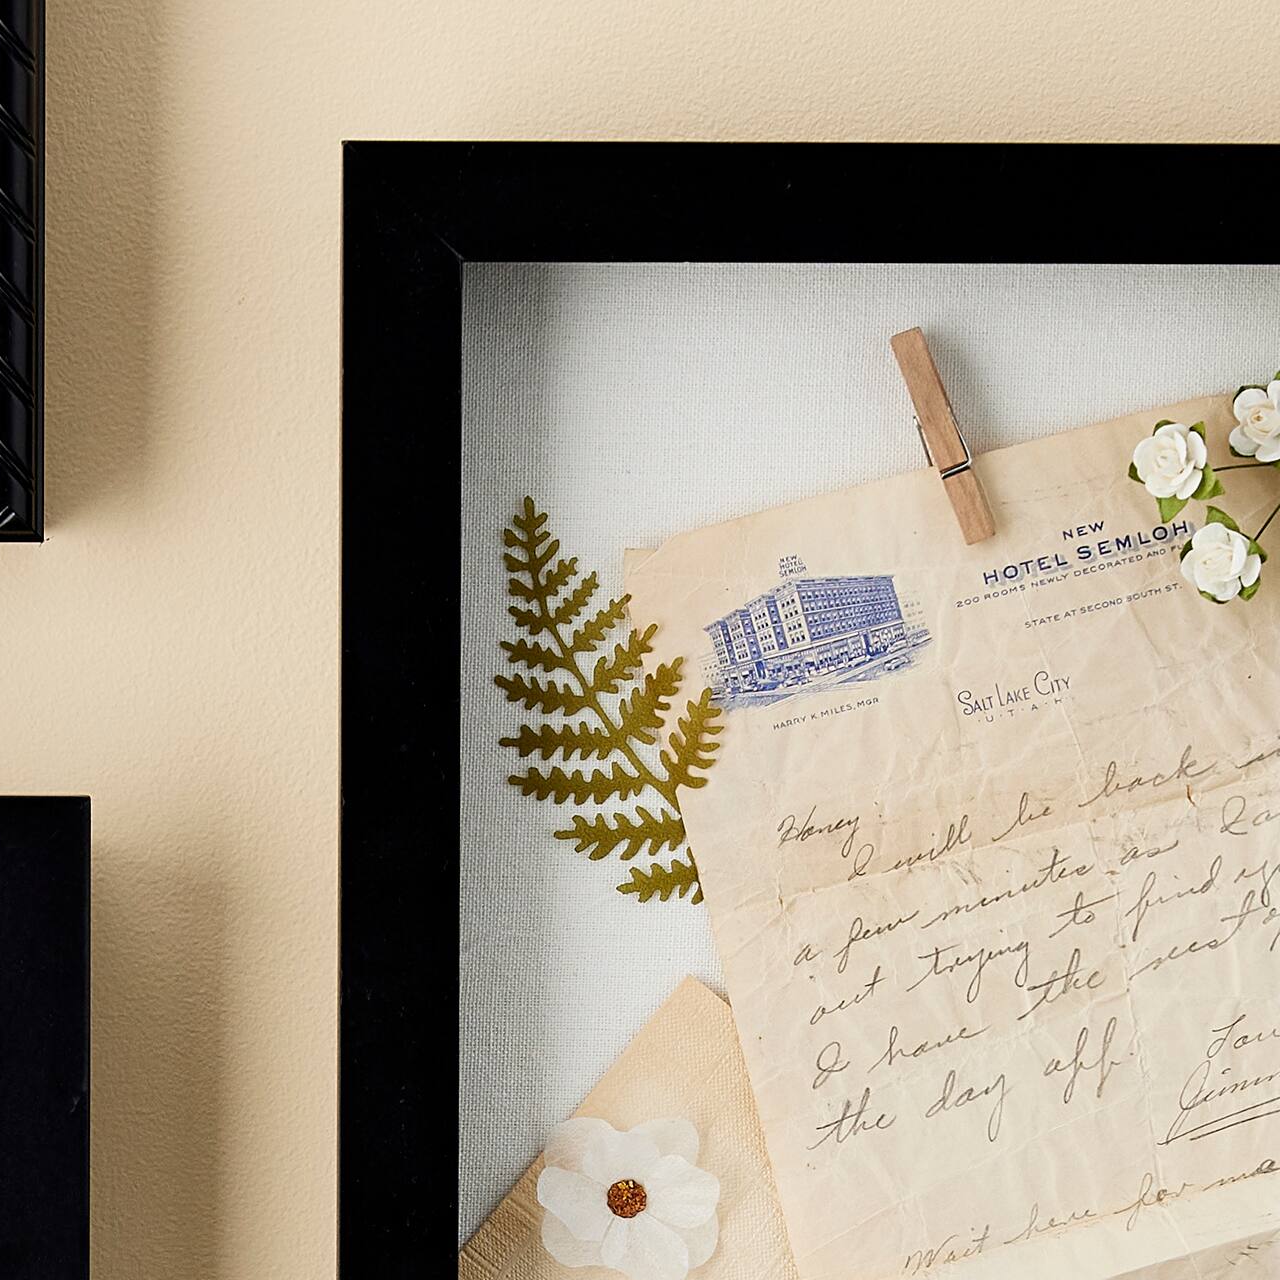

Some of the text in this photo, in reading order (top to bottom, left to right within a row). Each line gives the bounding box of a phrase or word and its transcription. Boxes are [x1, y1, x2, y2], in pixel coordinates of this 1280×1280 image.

[780, 558, 803, 570] HOTEL
[983, 520, 1191, 585] HOTEL SEMLOH
[1062, 520, 1105, 541] NEW
[955, 594, 980, 608] 200
[983, 584, 1026, 600] ROOMS
[1030, 573, 1070, 588] NEWLY
[1073, 555, 1143, 577] DECORATED
[1146, 548, 1167, 561] AND
[1024, 614, 1061, 629] STATE
[1063, 609, 1078, 619] AT
[1079, 597, 1124, 614] SECOND
[1126, 587, 1162, 603] SOUTH
[772, 715, 807, 731] HARRY
[810, 712, 818, 720] K
[882, 814, 973, 874] will
[1078, 745, 1218, 808] back
[793, 943, 823, 967] a
[833, 916, 920, 975] few
[921, 848, 1096, 930] minutes
[1119, 840, 1179, 866] as
[809, 966, 887, 1026] out
[905, 929, 1029, 1004] trying
[1048, 891, 1124, 939] to
[1125, 855, 1223, 942] find
[867, 1026, 992, 1074] have
[1016, 948, 1108, 1022] the
[806, 1087, 898, 1151] the
[925, 1069, 1014, 1143] day
[903, 1171, 1196, 1276] Wait here for
